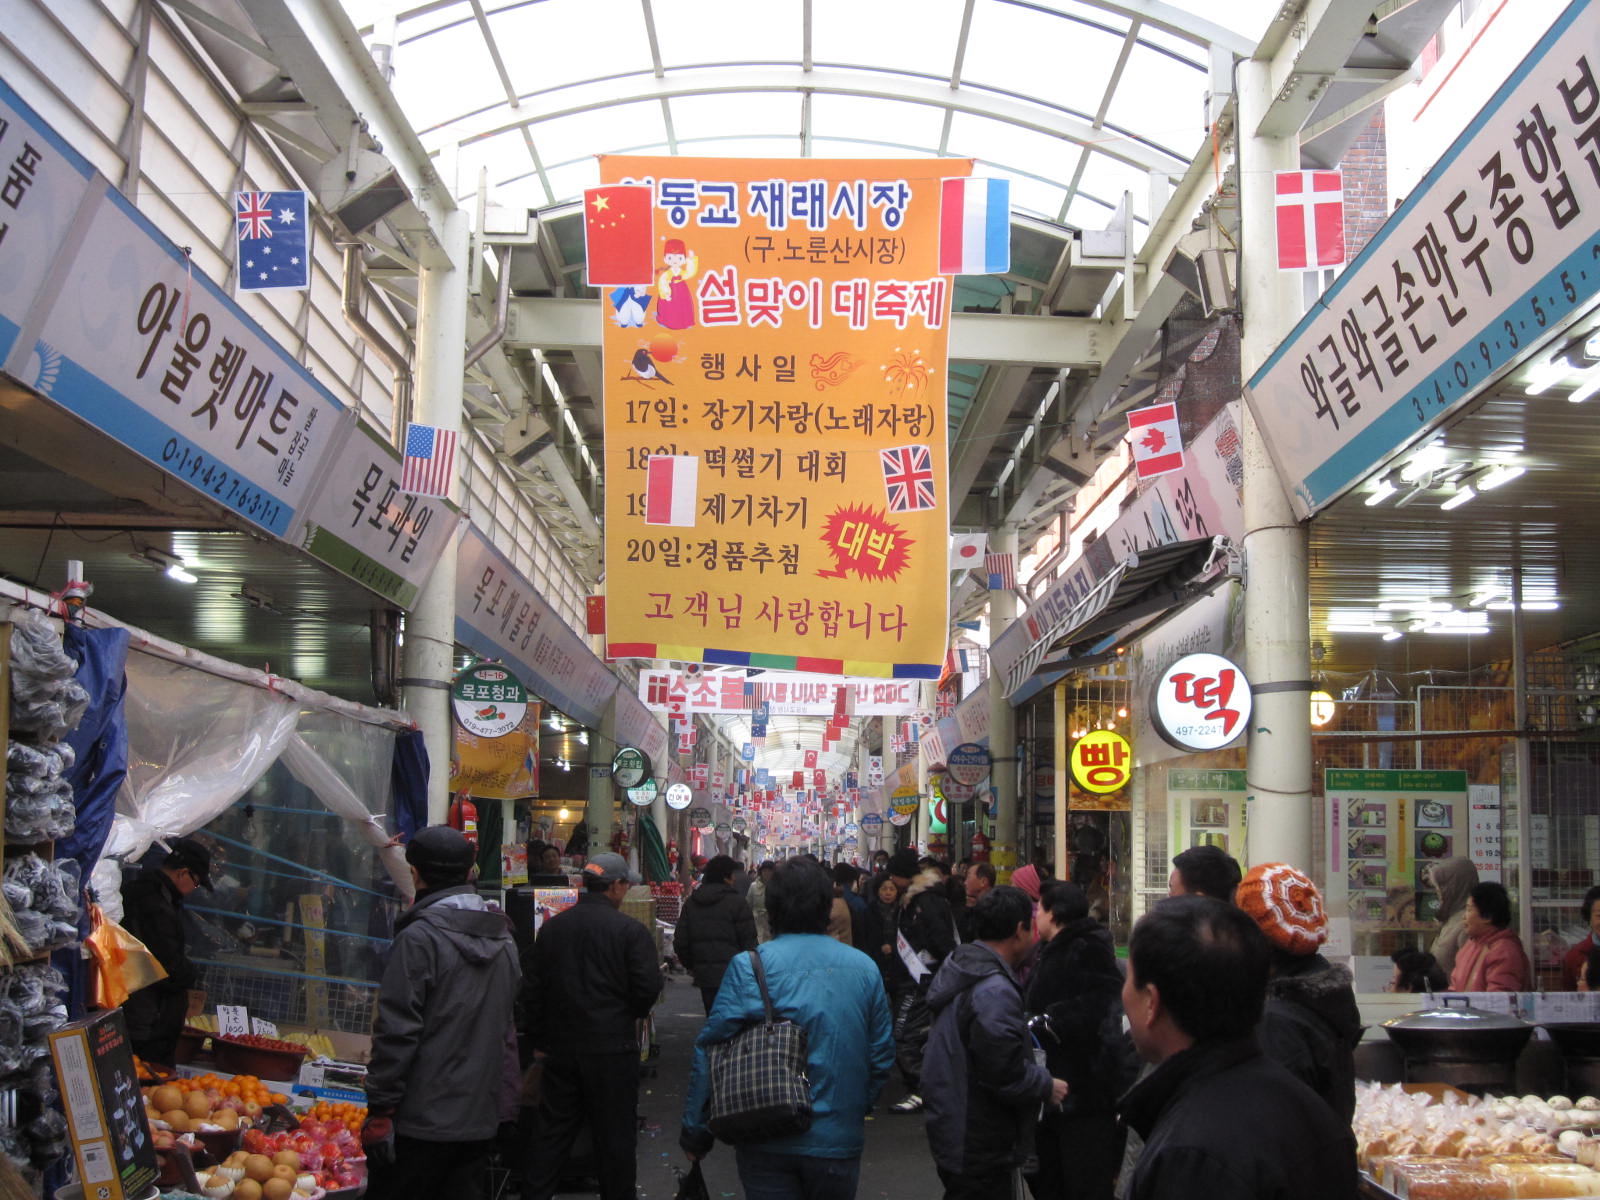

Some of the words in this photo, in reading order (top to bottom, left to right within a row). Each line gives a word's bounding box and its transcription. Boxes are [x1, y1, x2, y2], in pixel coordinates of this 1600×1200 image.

[620, 177, 740, 229] 동교
[748, 179, 912, 230] 재래시장
[744, 236, 906, 265] (구.노룬산시장)
[832, 277, 947, 330] 대축제
[137, 282, 299, 456] 아울렛마트
[626, 397, 689, 429] 17일:
[702, 398, 935, 438] 장기자랑(노래자랑)
[704, 446, 783, 479] 떡썰기
[797, 451, 847, 483] 대회
[352, 463, 433, 564] 목포과일
[702, 494, 808, 530] 제기차기
[838, 520, 896, 570] 대박
[644, 593, 745, 630] 고객님
[755, 595, 908, 643] 사랑합니다
[462, 684, 519, 701] 목포청과
[1170, 668, 1240, 737] 떡
[1175, 725, 1223, 736] 497-2247
[1080, 741, 1128, 786] 빵
